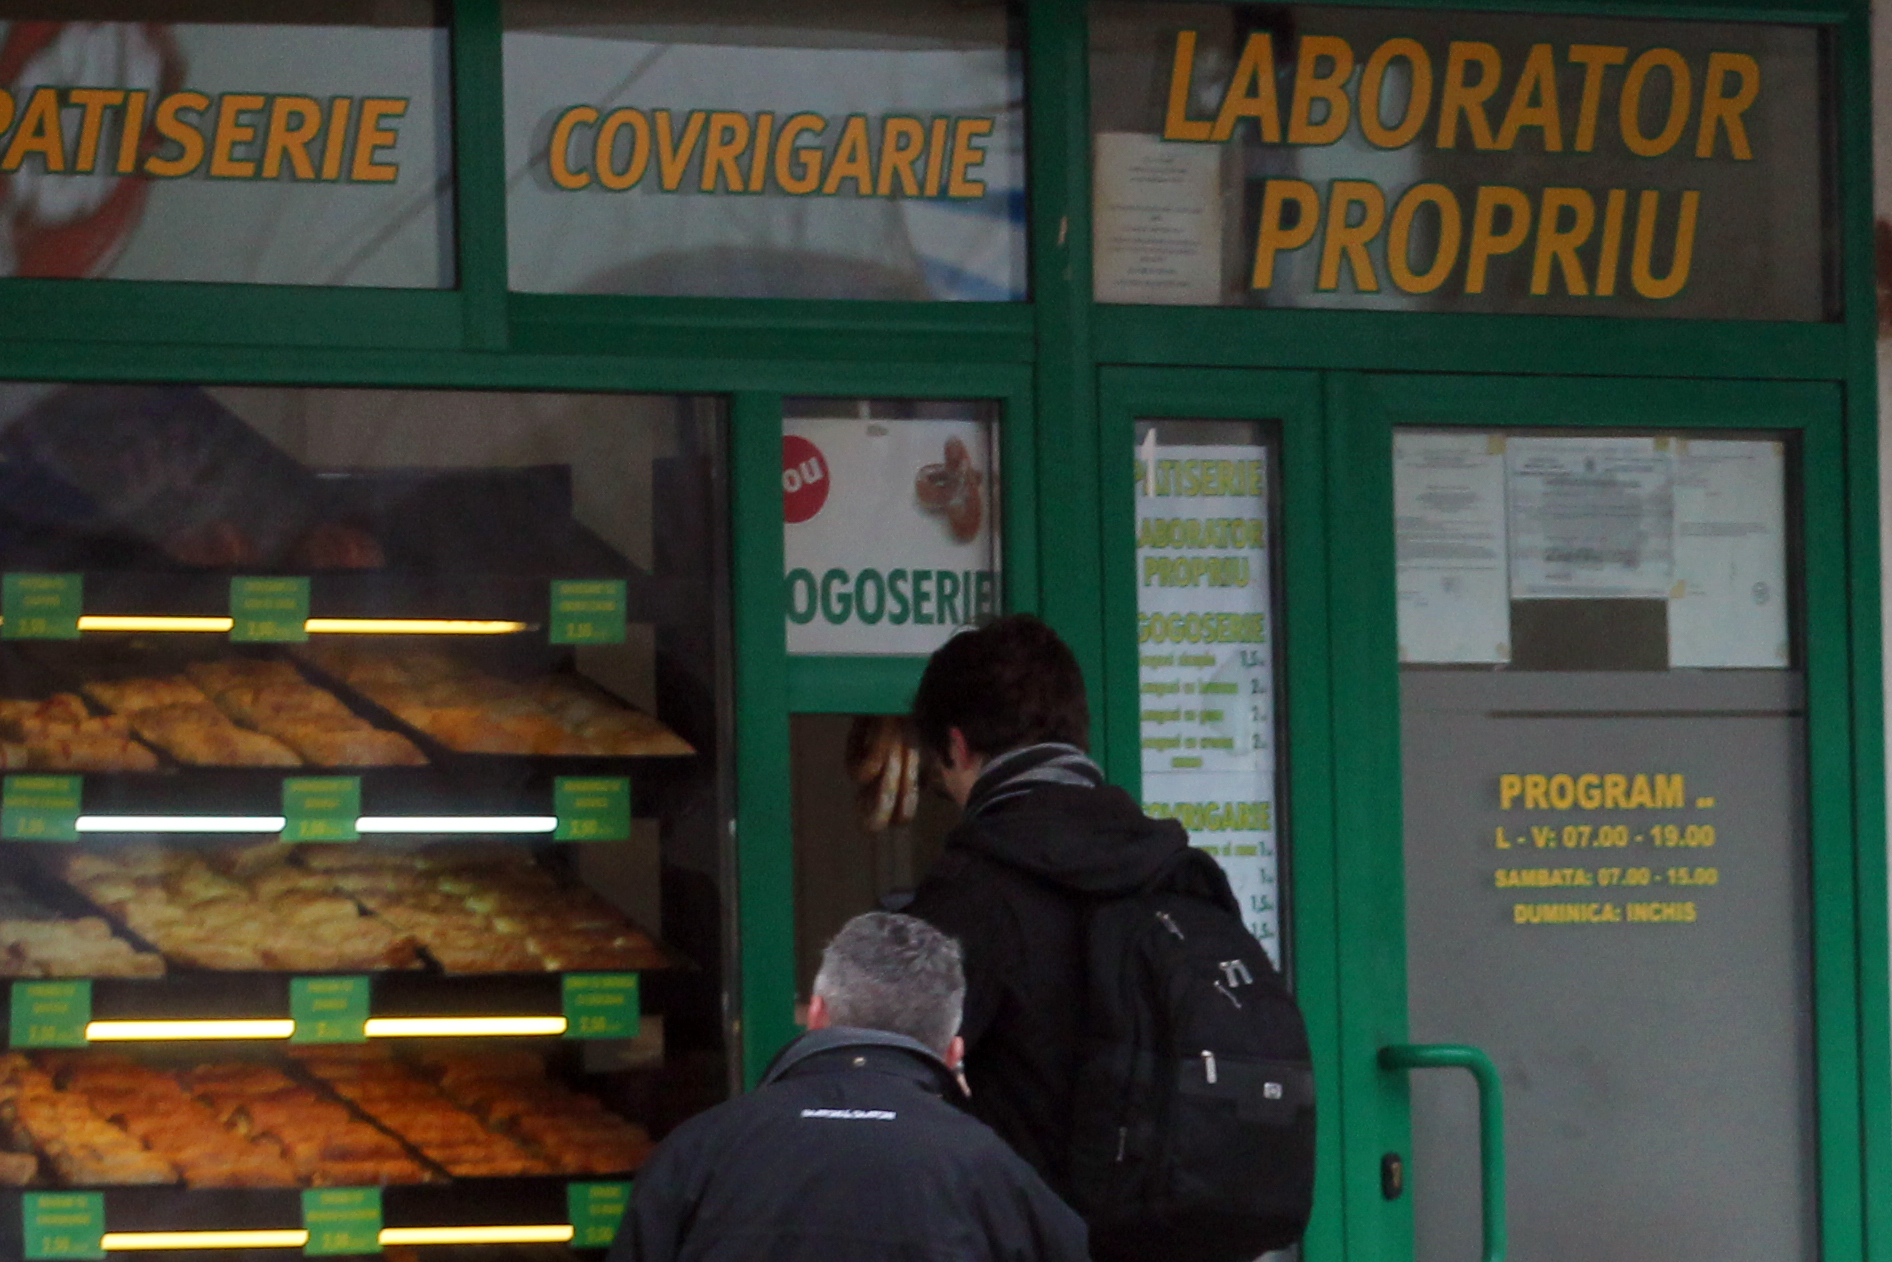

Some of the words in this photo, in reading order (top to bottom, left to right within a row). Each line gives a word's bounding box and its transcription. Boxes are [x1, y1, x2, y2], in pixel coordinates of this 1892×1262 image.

[1162, 28, 1762, 161] LABORATOR
[548, 104, 994, 197] COVRIGARIE
[1250, 178, 1701, 299] PROPRIU
[1501, 773, 1685, 809] PROGRAM
[1562, 825, 1629, 847] 07.00
[1651, 824, 1716, 847] 19.00
[1626, 901, 1697, 922] INCHIS
